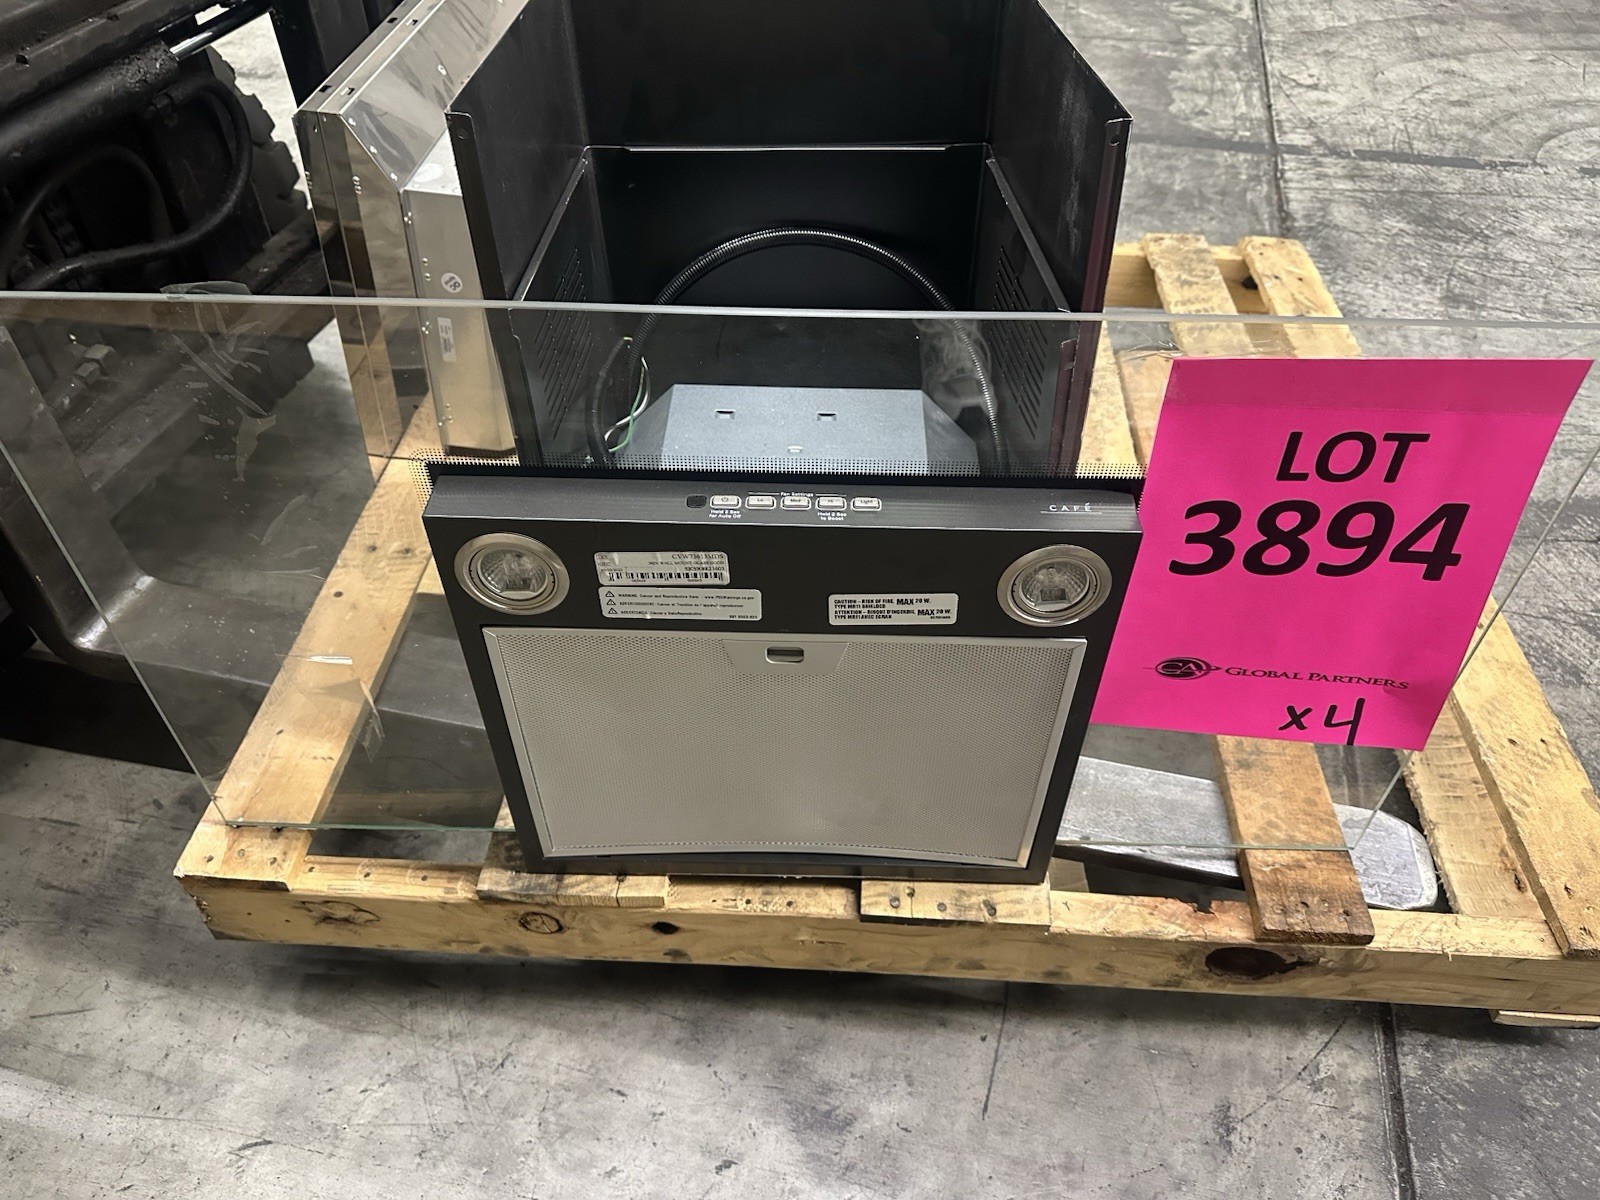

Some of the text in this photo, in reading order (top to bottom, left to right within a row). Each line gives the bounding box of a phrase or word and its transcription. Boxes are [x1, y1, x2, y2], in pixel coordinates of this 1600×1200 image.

[1276, 431, 1431, 483] LOT
[1049, 502, 1092, 512] CAFÉ
[1168, 500, 1471, 581] 3894
[1225, 667, 1302, 681] GLOBAL
[1307, 672, 1409, 690] PARTNERS
